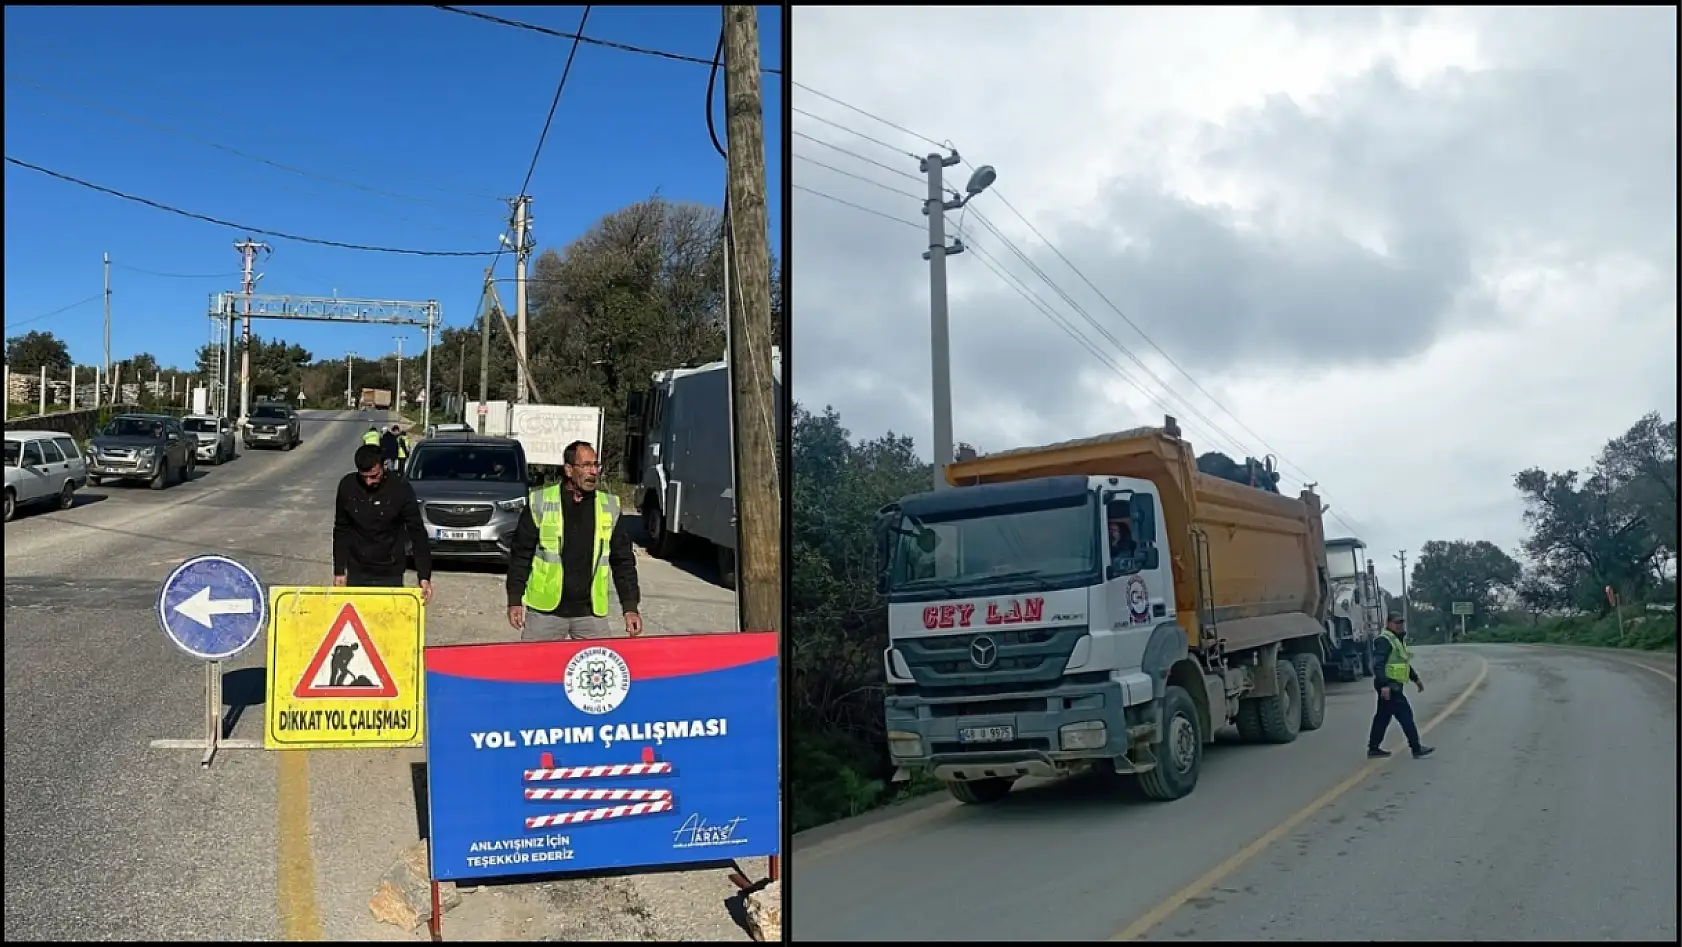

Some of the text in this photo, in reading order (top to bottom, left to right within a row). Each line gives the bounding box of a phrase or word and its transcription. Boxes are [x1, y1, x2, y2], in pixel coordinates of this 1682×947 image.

[923, 597, 1044, 628] CEY LAN
[279, 704, 411, 736] DİKKAT YOL ÇALIŞMASI
[471, 718, 727, 749] YOL YAPIM ÇALIŞMASI
[470, 834, 570, 852] ANLAYIŞINIZ İÇİN
[695, 831, 728, 842] ARAS
[467, 847, 574, 868] TEŞEKKÜR EDERİZ
